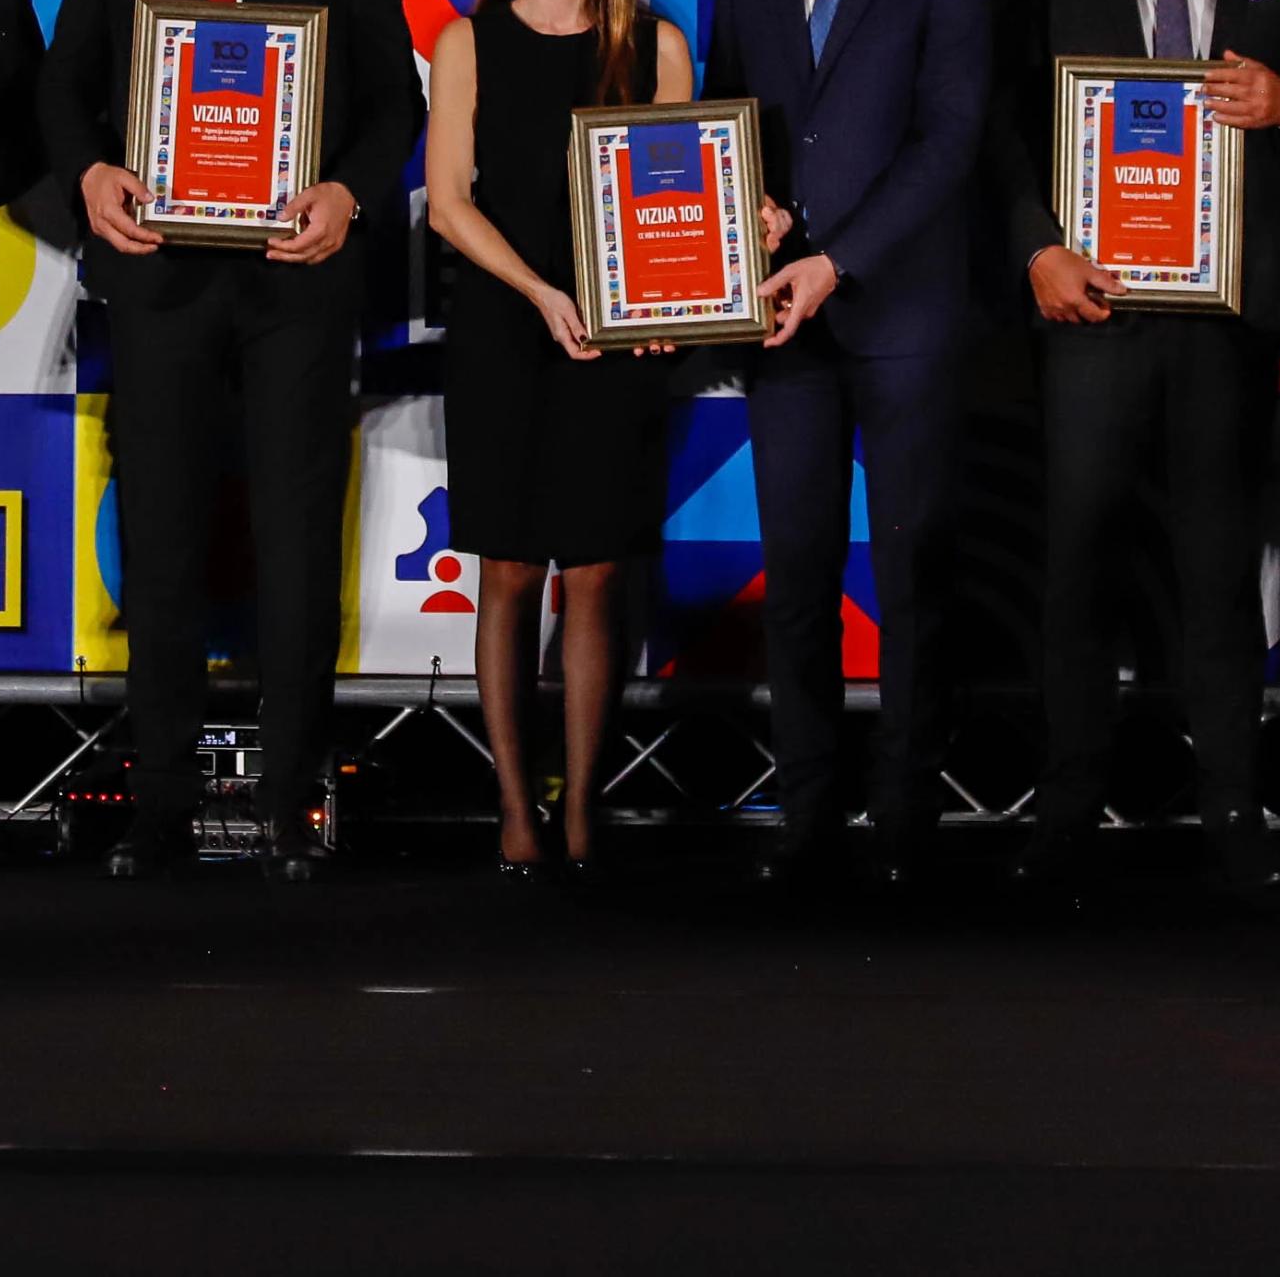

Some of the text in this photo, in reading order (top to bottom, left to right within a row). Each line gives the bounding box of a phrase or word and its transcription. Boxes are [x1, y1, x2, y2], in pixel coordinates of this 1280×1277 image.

[192, 104, 259, 125] VIZIJA 100
[1115, 166, 1180, 185] VIZIJA 100
[635, 205, 703, 225] VIZIJA 100
